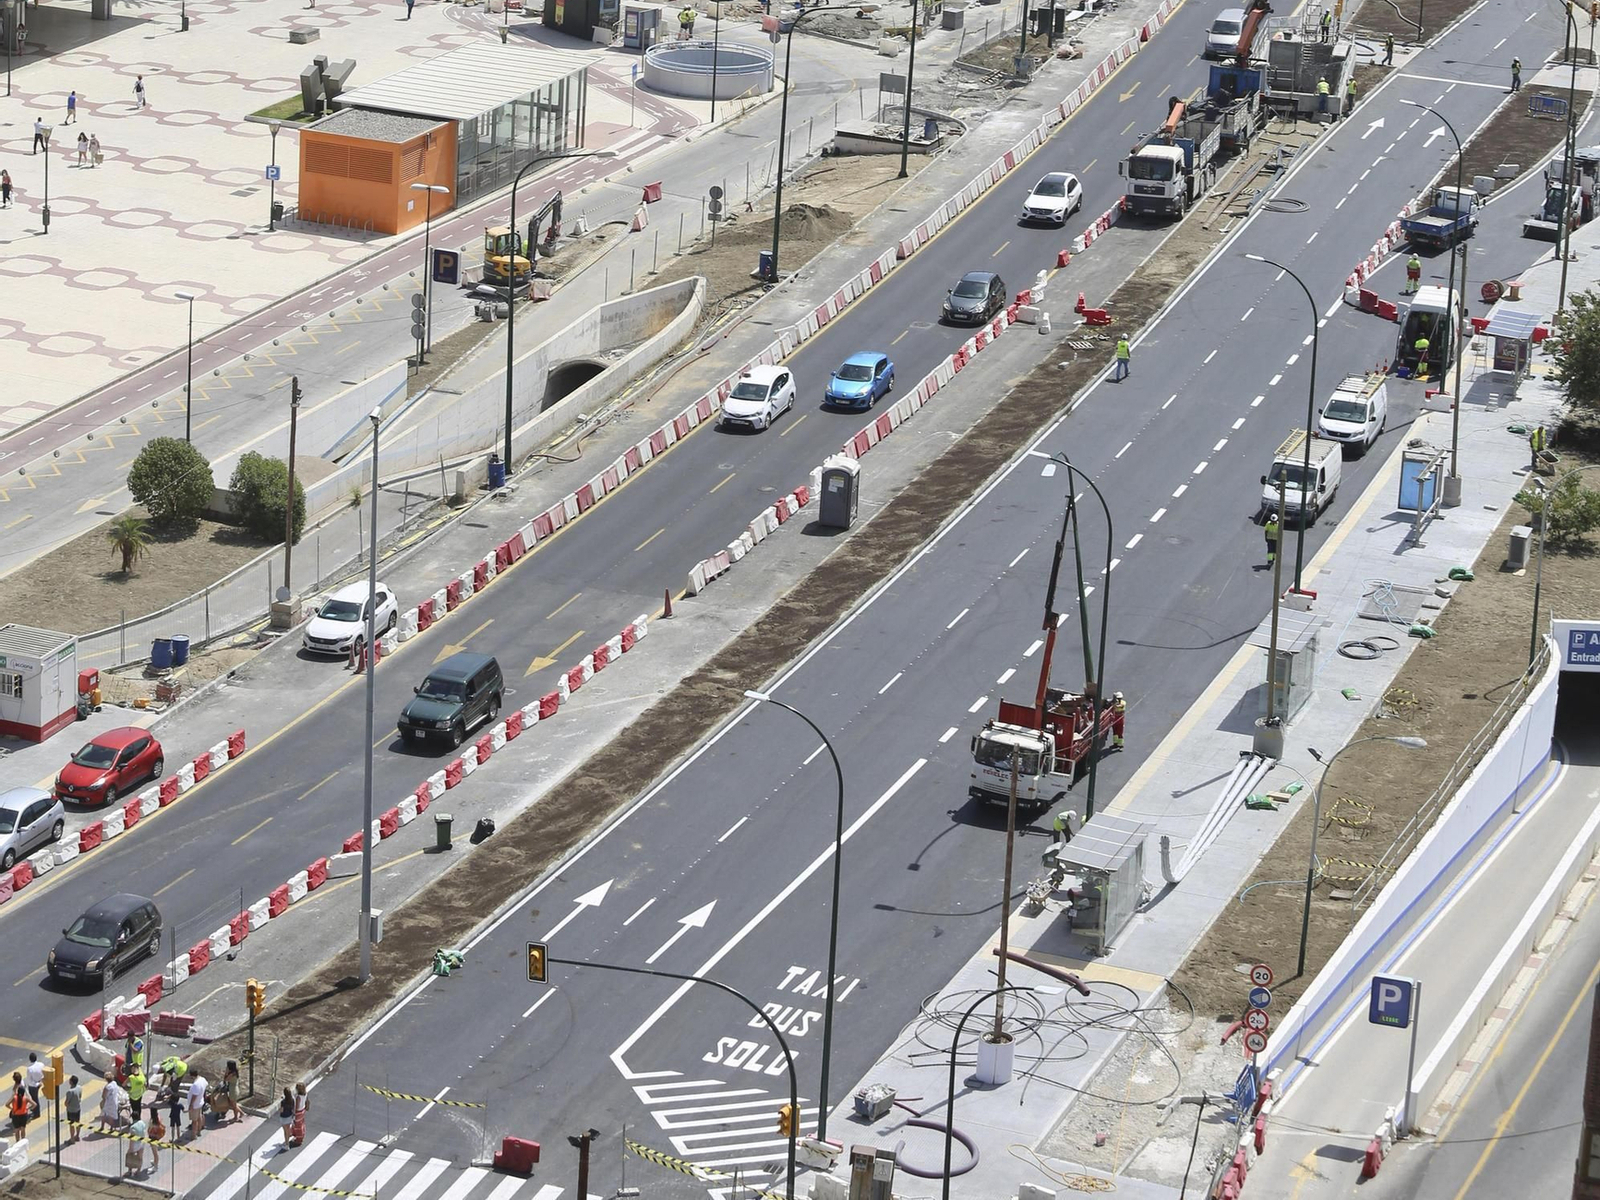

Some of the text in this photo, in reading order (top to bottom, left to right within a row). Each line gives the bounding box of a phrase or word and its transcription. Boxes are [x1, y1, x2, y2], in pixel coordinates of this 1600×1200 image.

[439, 254, 454, 274] P
[1575, 634, 1584, 643] P
[776, 965, 861, 1003] TAXI
[1255, 971, 1269, 981] 20
[1378, 982, 1402, 1012] P
[747, 1002, 823, 1037] BUS
[702, 1036, 800, 1076] SOLO
